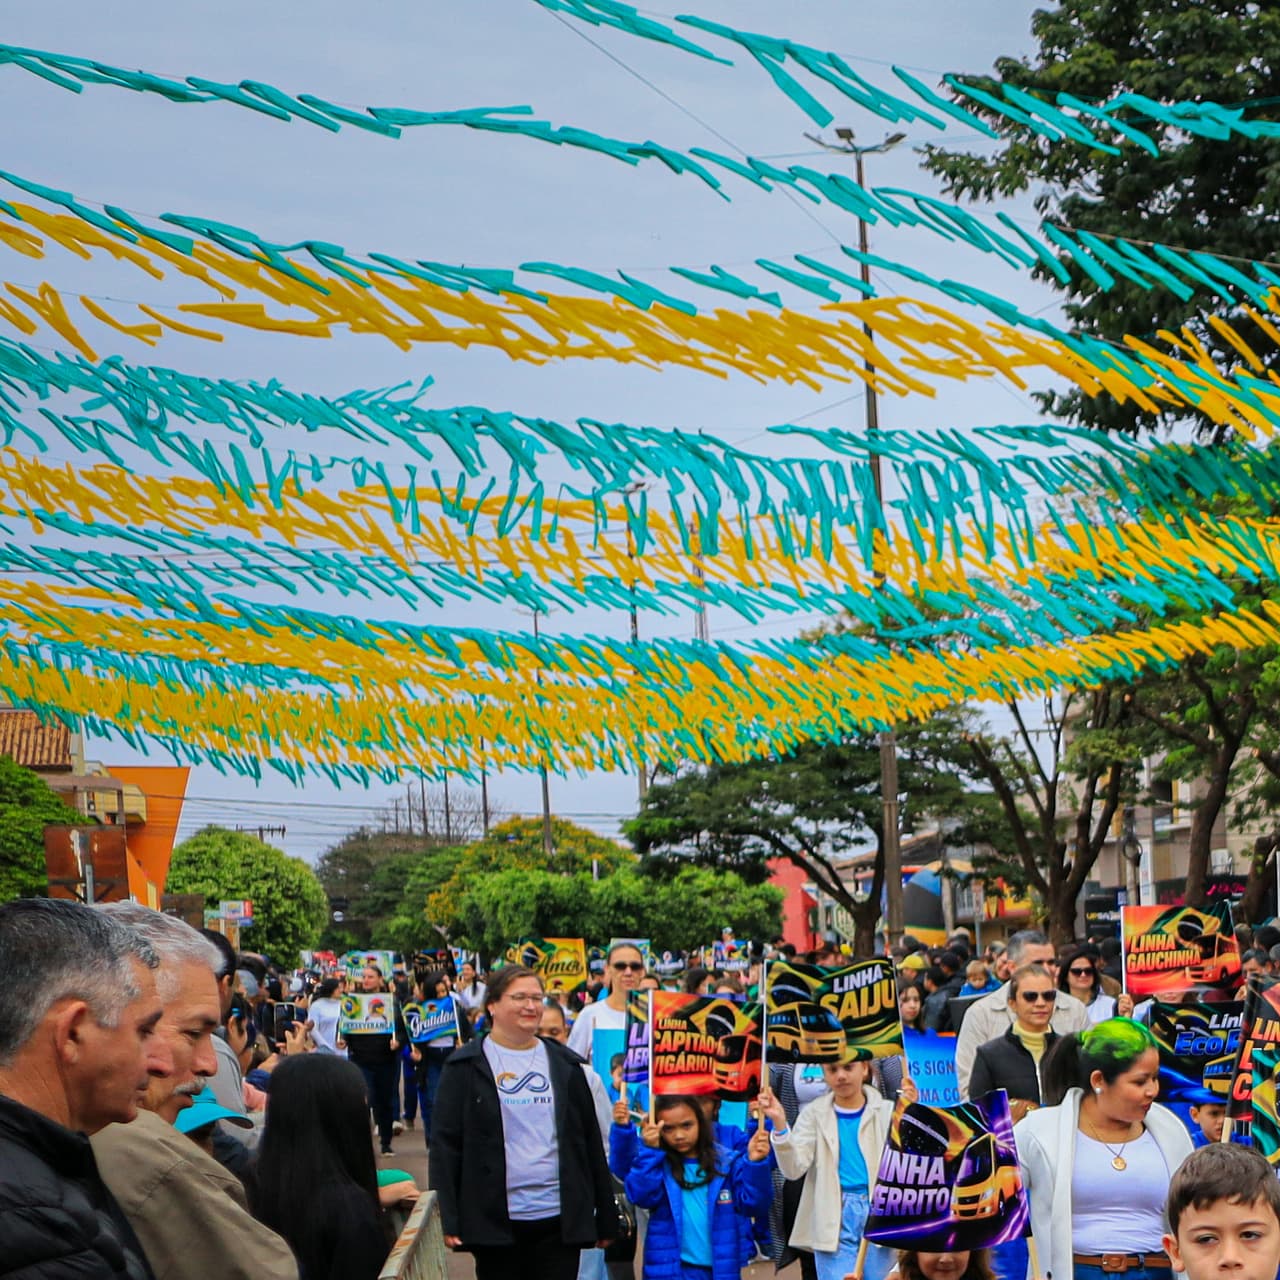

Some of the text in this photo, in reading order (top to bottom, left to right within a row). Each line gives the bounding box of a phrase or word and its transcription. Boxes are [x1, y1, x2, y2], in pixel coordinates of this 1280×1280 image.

[1131, 934, 1176, 953] LINHA
[1127, 949, 1201, 973] GAUCHINHA
[833, 964, 884, 993] LINHA
[820, 978, 896, 1021] SAIJU
[658, 1018, 687, 1029] LINHA
[1208, 1012, 1244, 1029] Lin
[870, 1184, 951, 1217] ERRITO
